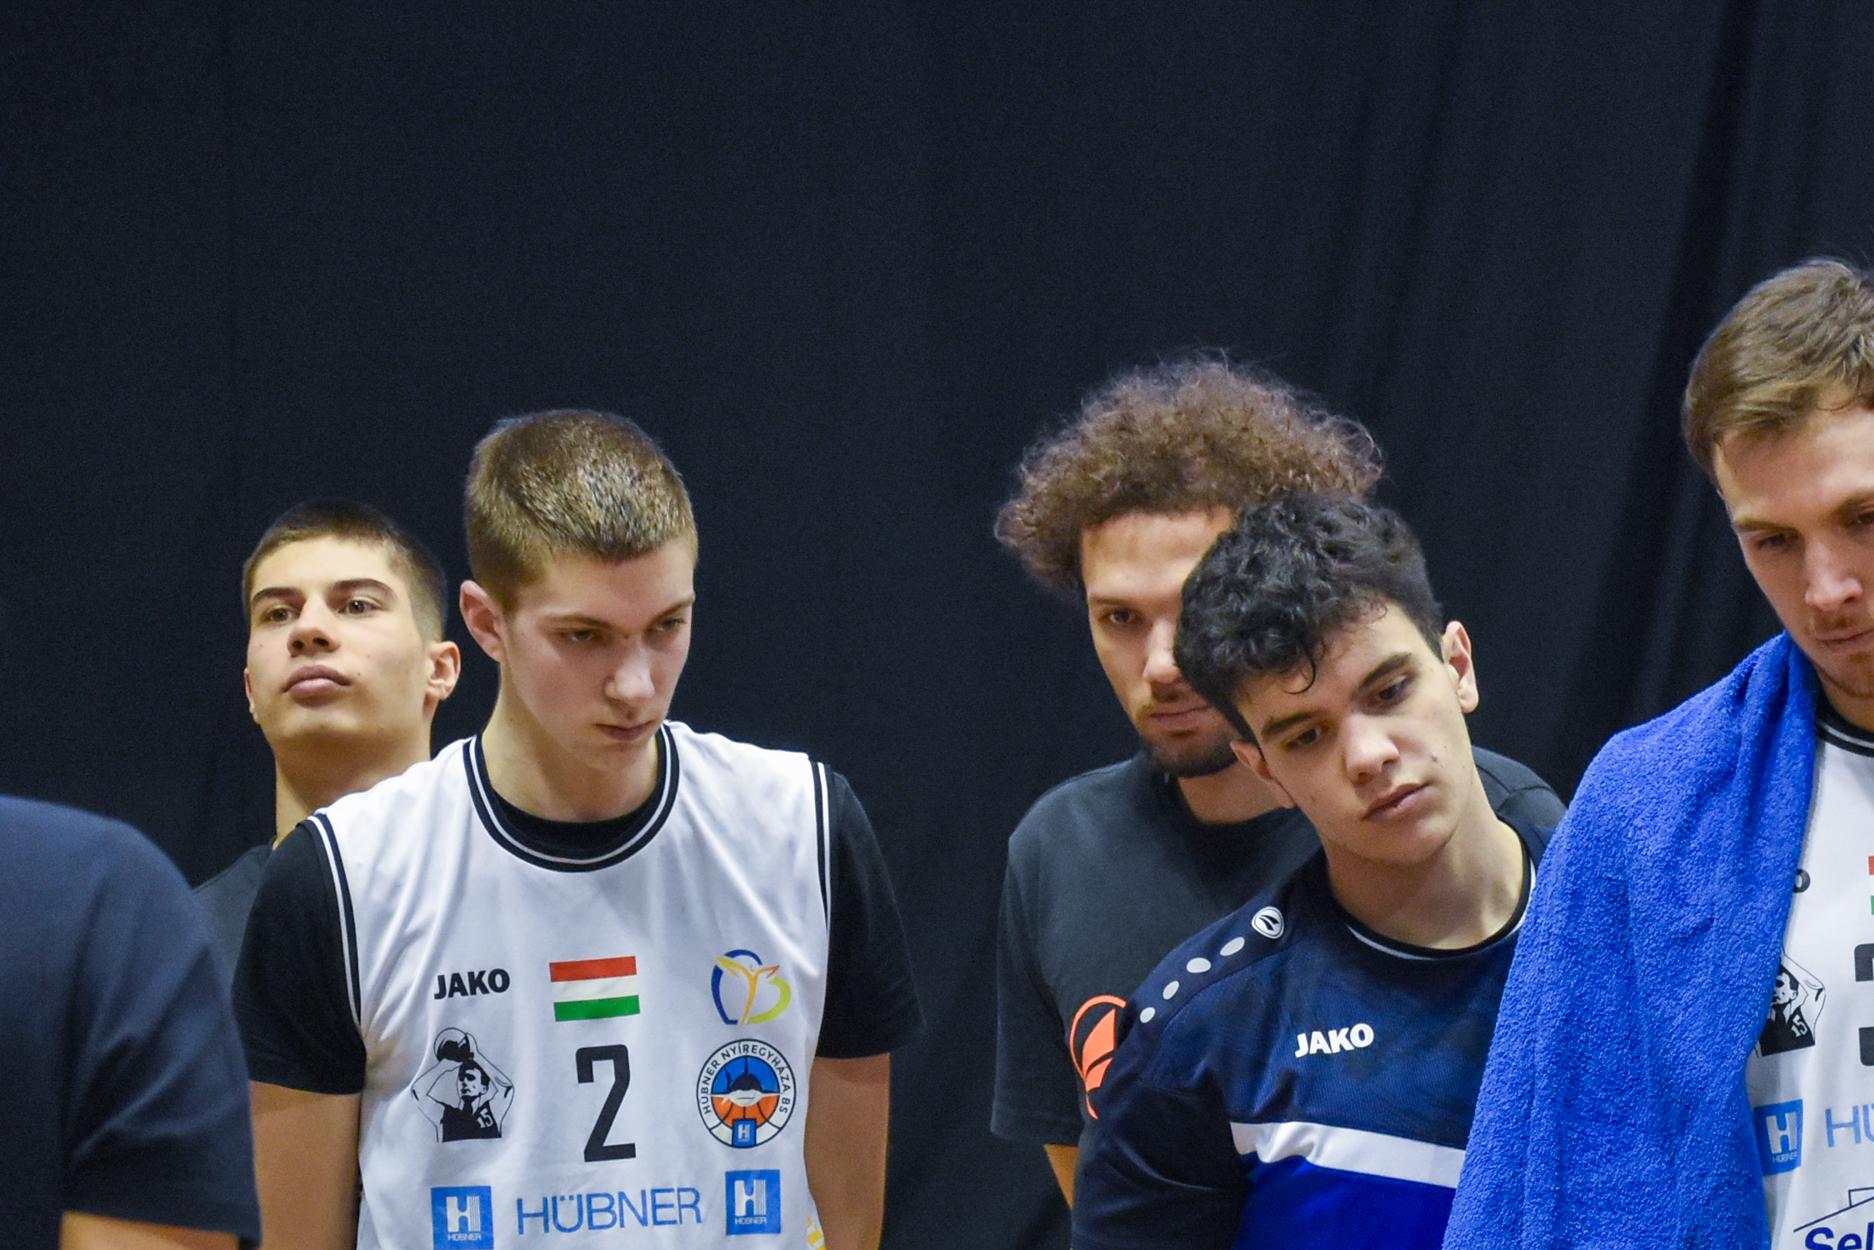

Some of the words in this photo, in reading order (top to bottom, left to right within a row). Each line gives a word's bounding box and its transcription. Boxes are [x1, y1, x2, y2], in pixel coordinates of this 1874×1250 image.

[433, 968, 511, 1000] JAKO
[1294, 1022, 1375, 1058] JAKO
[575, 1044, 637, 1163] 2
[778, 1096, 791, 1114] BS
[516, 1186, 703, 1236] HÜBNER
